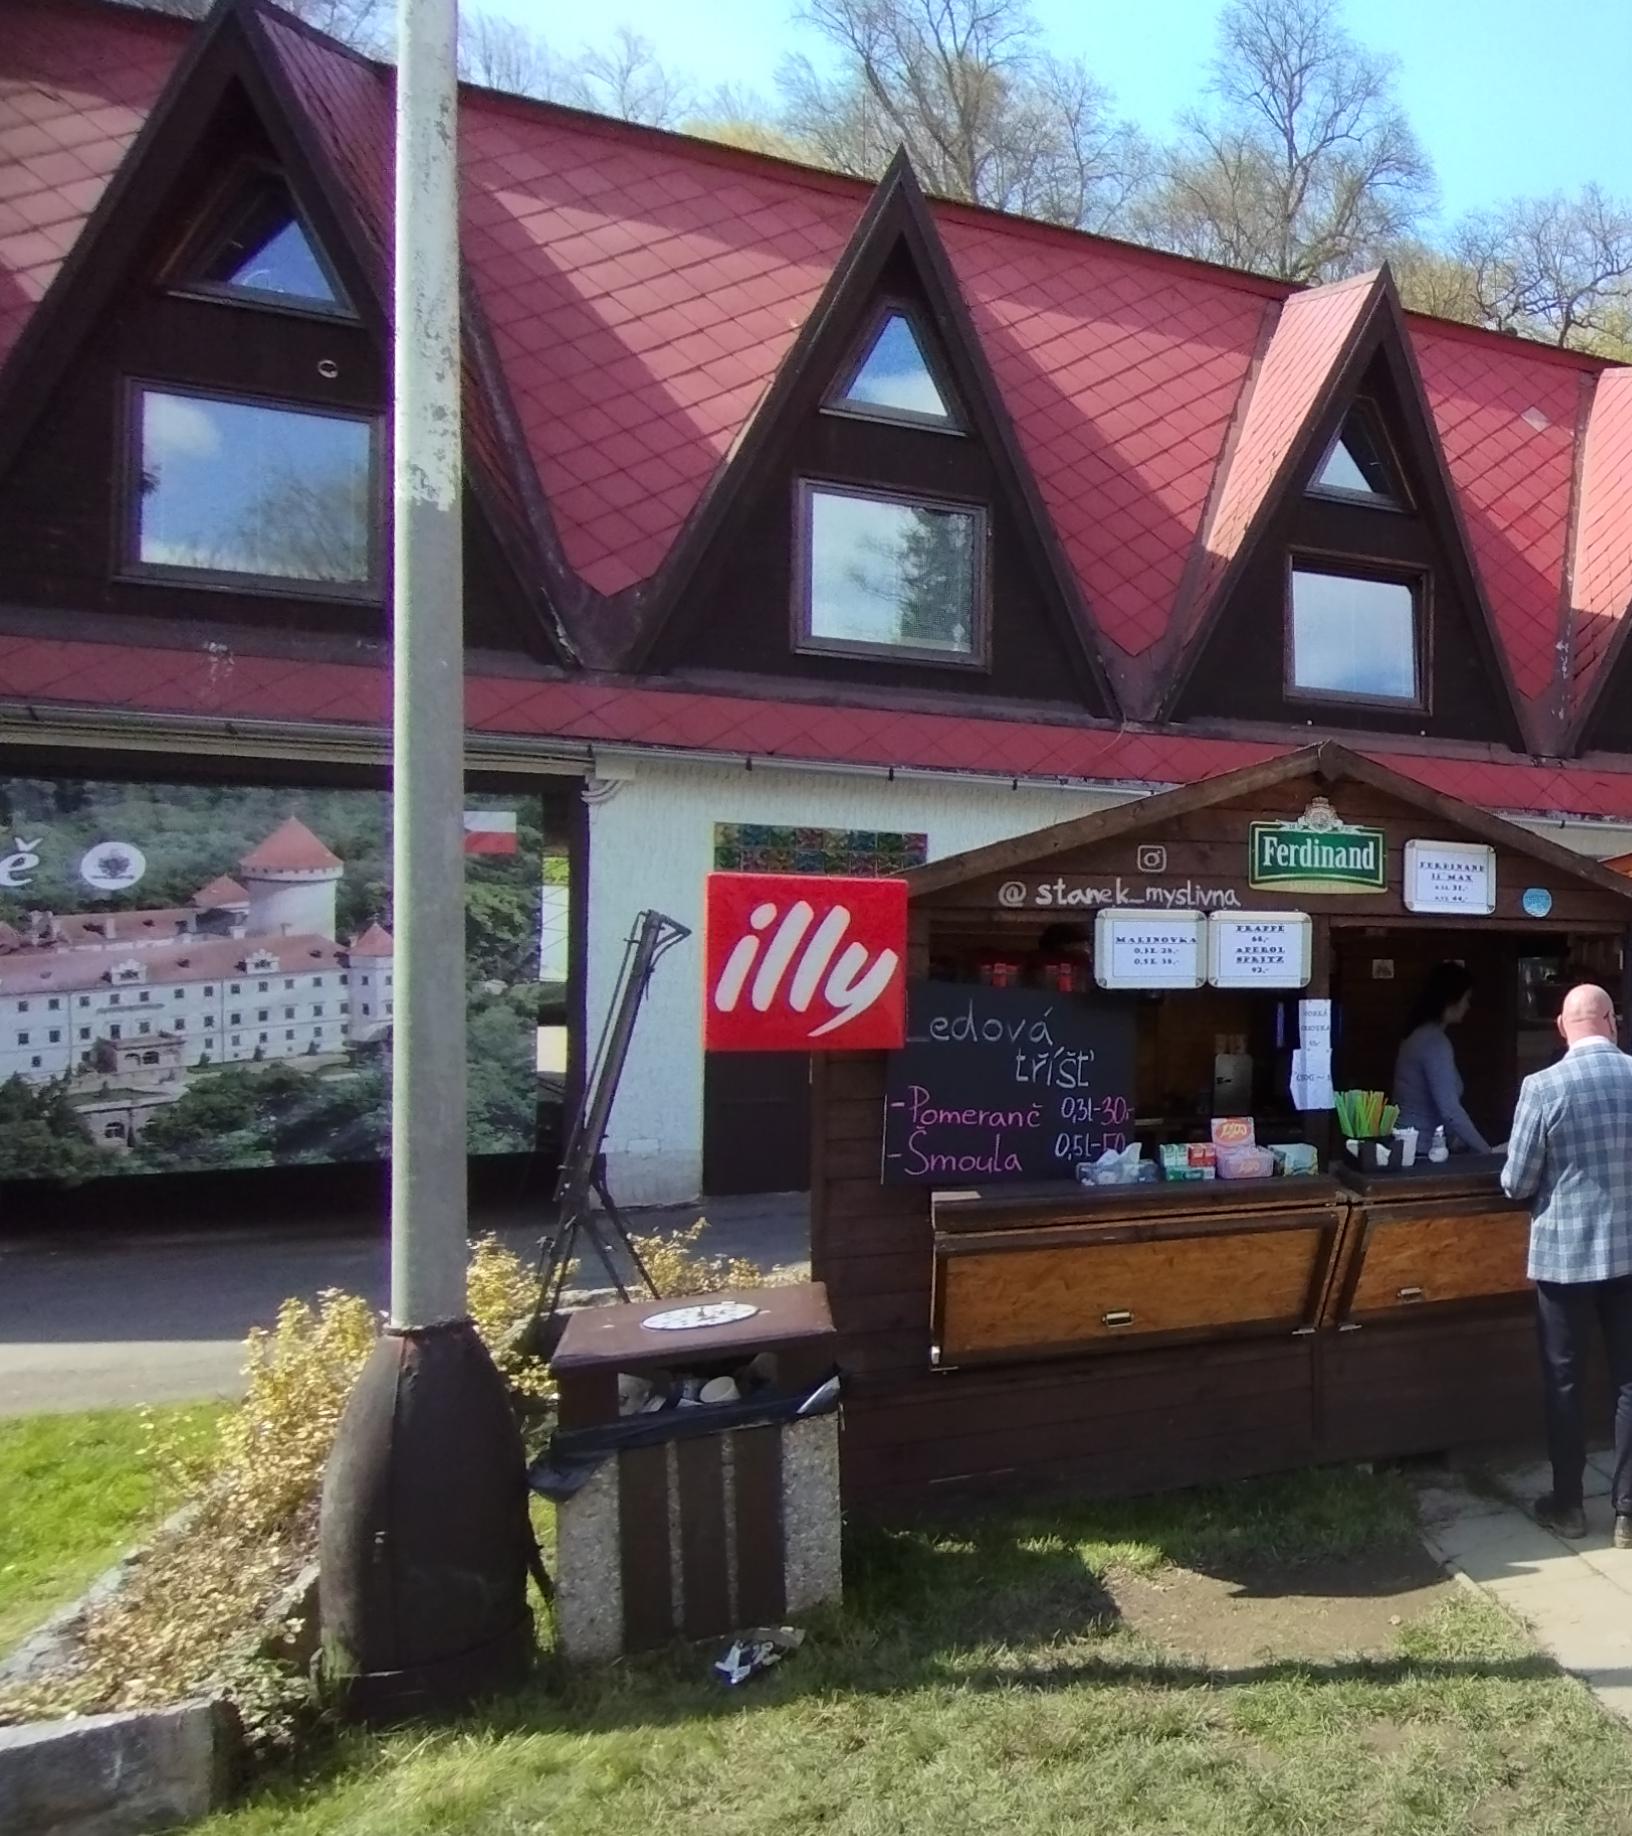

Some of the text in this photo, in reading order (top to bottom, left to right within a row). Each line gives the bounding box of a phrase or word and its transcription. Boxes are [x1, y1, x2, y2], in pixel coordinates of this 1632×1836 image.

[1262, 835, 1376, 871] Ferdinand
[1115, 936, 1198, 944] MALINOVKA
[714, 901, 899, 1036] illy
